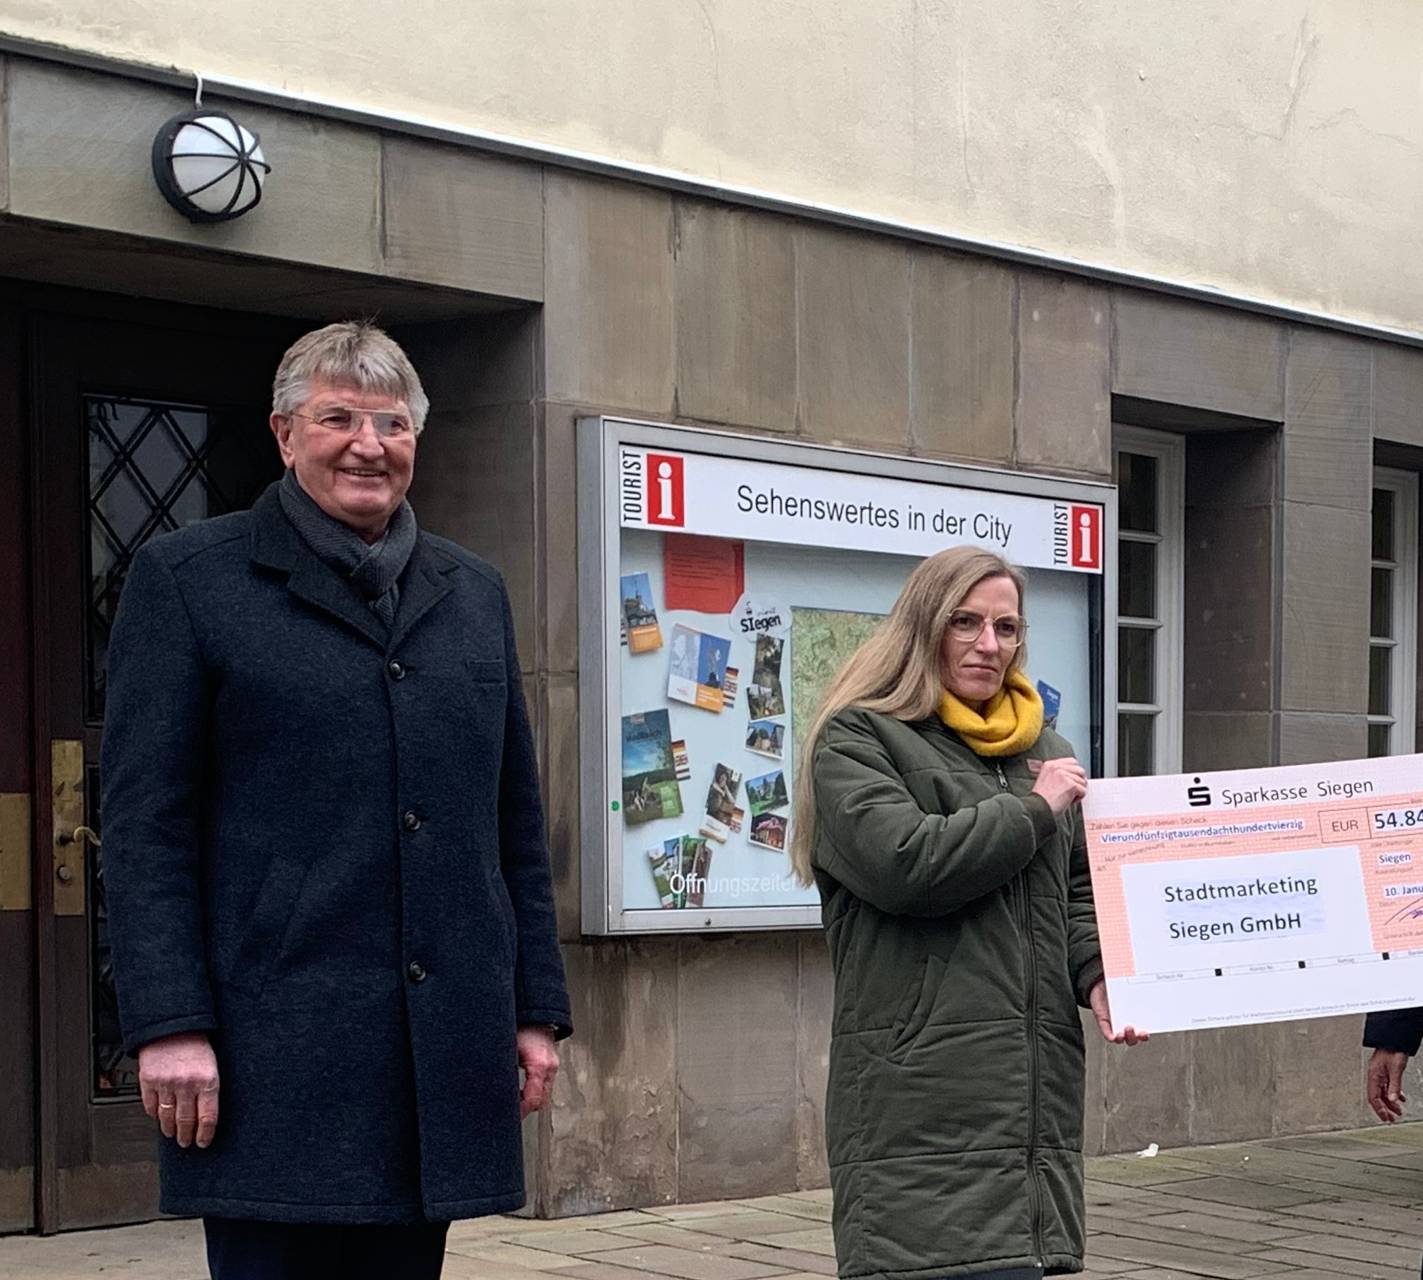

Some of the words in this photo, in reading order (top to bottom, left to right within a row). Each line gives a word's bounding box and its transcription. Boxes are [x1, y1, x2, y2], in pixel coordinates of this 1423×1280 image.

[622, 450, 642, 523] TOURIST
[737, 484, 900, 529] Sehenswertes
[908, 504, 926, 532] in
[932, 508, 967, 537] der
[973, 512, 1013, 548] City
[1053, 503, 1069, 565] TOURIST
[1222, 786, 1309, 809] Sparkasse
[1317, 780, 1374, 798] Siegen
[1101, 820, 1304, 843] Vierundfünfzigtausendachthundertvierzig
[1331, 819, 1360, 833] EUR
[1378, 853, 1412, 865] Siegen
[1164, 876, 1319, 903] Stadtmarketing
[1384, 887, 1400, 897] 10.
[1169, 920, 1235, 941] Siegen
[1240, 913, 1303, 934] GmbH
